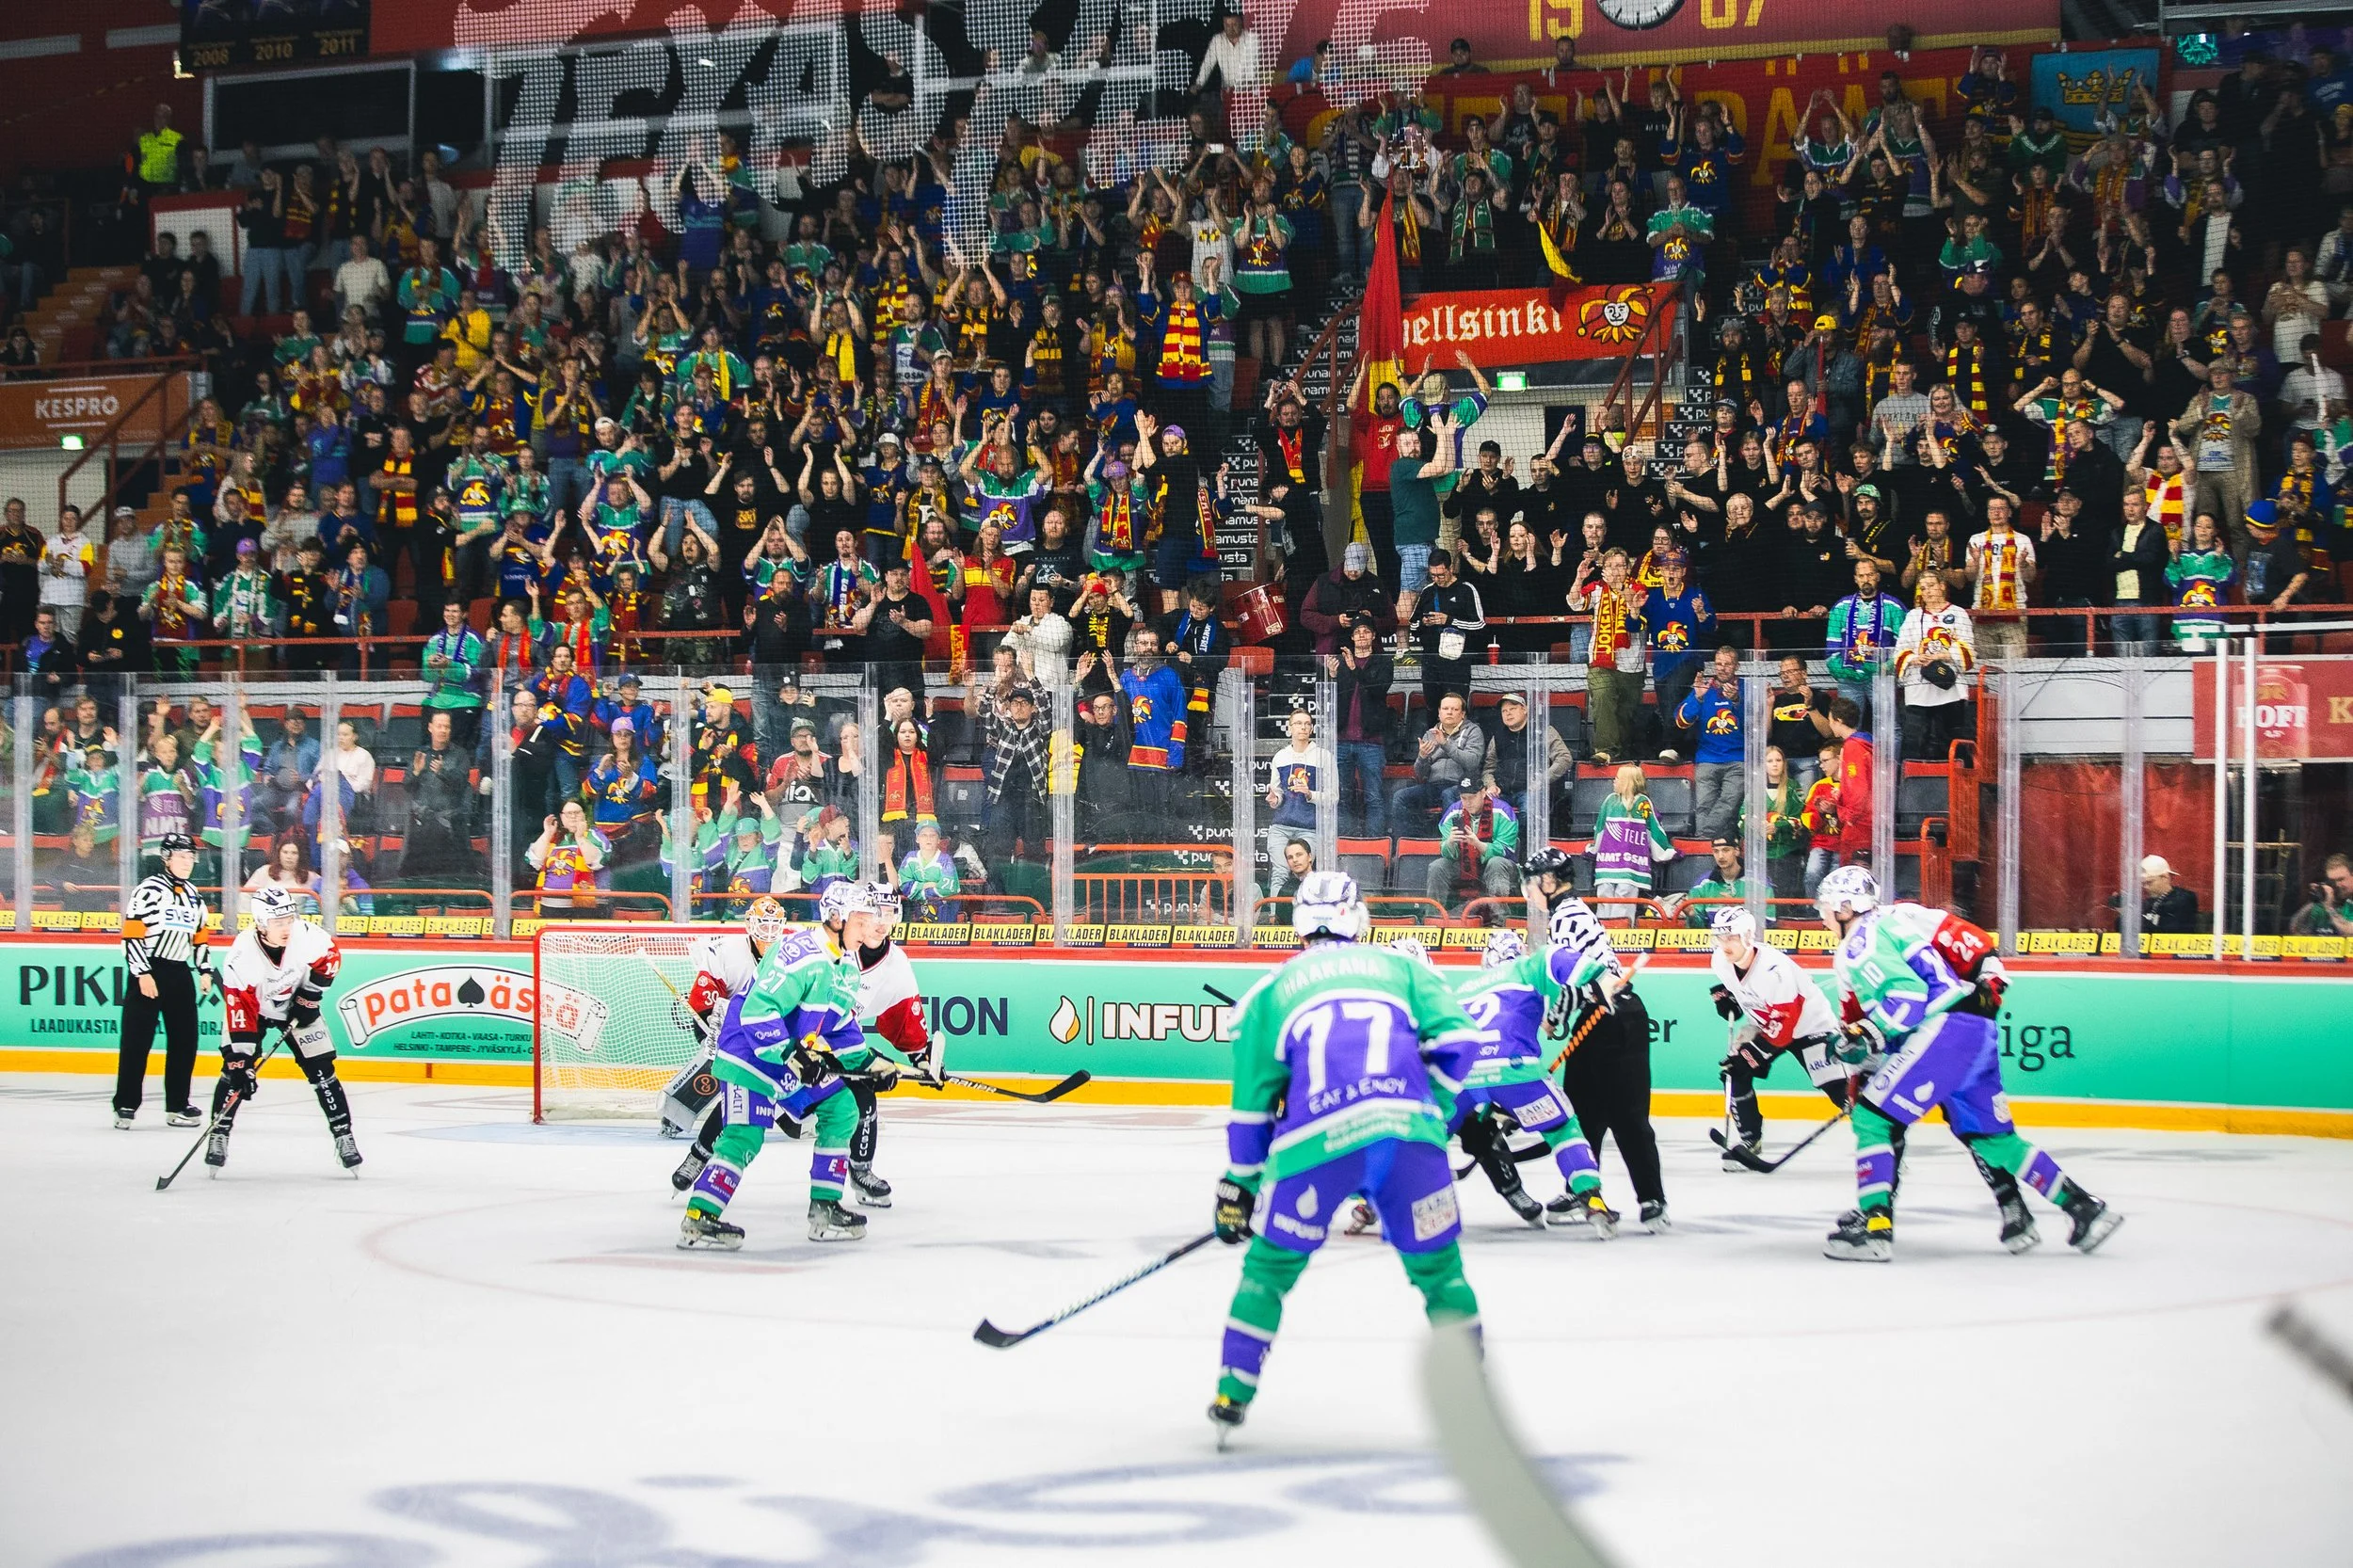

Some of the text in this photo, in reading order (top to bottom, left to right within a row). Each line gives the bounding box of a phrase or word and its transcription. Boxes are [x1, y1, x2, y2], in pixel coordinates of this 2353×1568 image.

[319, 36, 355, 56] 2011
[35, 395, 120, 420] KESPRO
[144, 815, 188, 836] NMT
[1624, 827, 1646, 846] TELE
[1595, 851, 1649, 867] NMT GSM
[1953, 930, 1984, 963] 24
[325, 960, 339, 977] 14
[1861, 962, 1886, 989] 10
[759, 970, 787, 995] 27
[364, 978, 452, 1027] pata
[31, 1018, 118, 1034] LAADUKASTA
[230, 1009, 247, 1029] 14
[297, 1030, 328, 1048] ABLOY
[410, 1031, 533, 1043] LAHTI KOTKA VAASA TURKU
[2000, 1011, 2076, 1072] iga
[393, 1043, 429, 1053] HELSINKI
[435, 1044, 472, 1053] TAMPERE
[476, 1042, 522, 1055] JYVÄSKYLÄ
[672, 1064, 698, 1091] BAUER
[948, 1076, 998, 1094] BAUER
